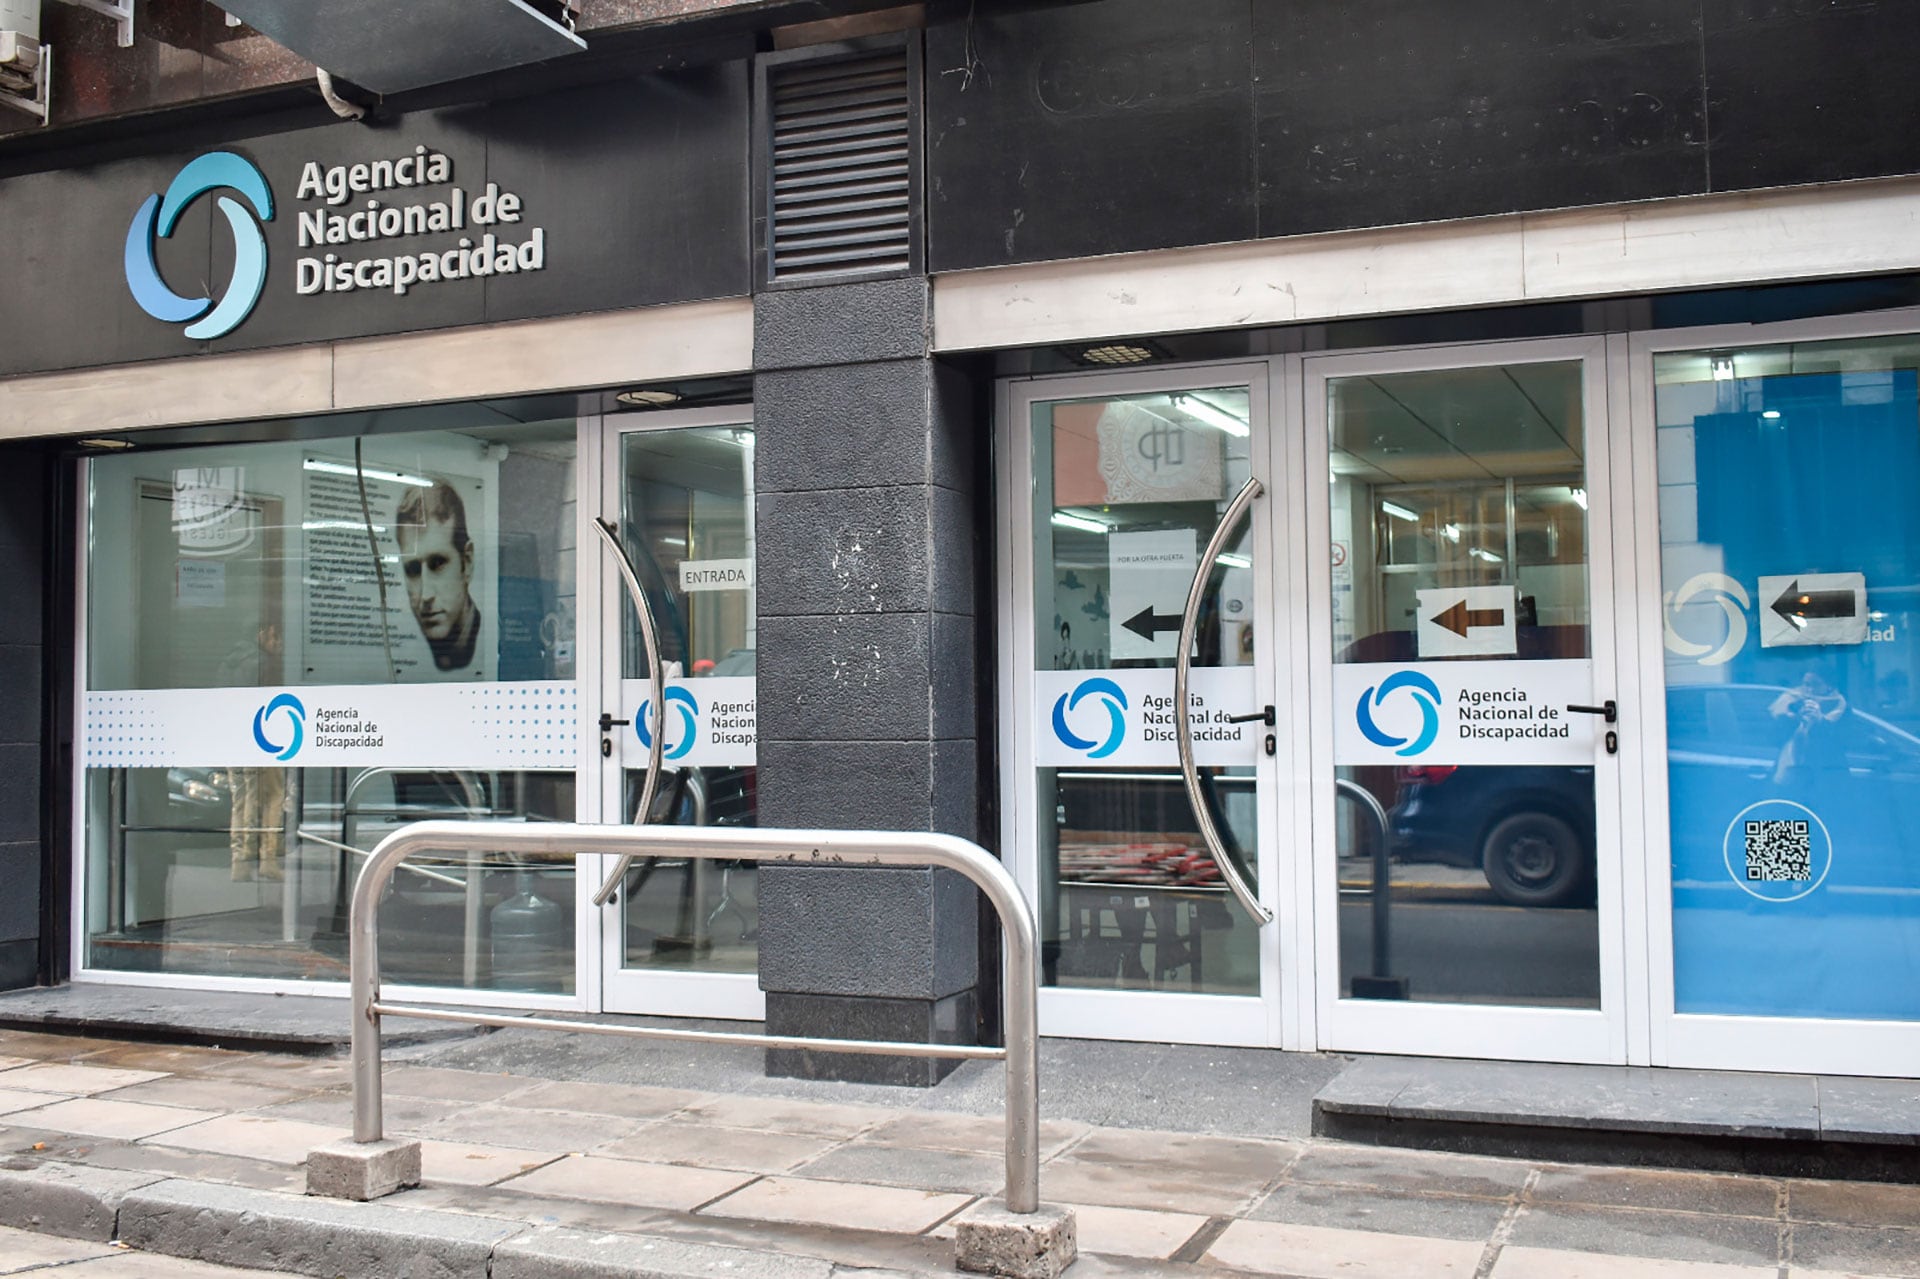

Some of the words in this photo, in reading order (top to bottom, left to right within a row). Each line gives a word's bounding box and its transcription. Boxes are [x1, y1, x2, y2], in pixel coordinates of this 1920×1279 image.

[296, 145, 451, 206] Agencia
[298, 187, 465, 248] Nacional
[471, 183, 522, 226] de
[296, 227, 545, 295] Discapacidad
[1141, 554, 1158, 562] OTRA
[1160, 553, 1184, 561] PUERTA
[685, 568, 746, 584] ENTRADA
[1143, 693, 1204, 711] Ageia
[1458, 687, 1527, 706] Agencia
[316, 707, 359, 722] Agencia
[1143, 710, 1209, 724] Nacinal
[1214, 710, 1232, 724] de
[1459, 705, 1533, 720] Nacional
[1538, 705, 1559, 720] de
[316, 721, 362, 733] Nacional
[364, 721, 378, 733] de
[1144, 727, 1241, 741] Discacidad
[1459, 723, 1569, 741] Discapacidad
[316, 735, 384, 750] Discapacidad
